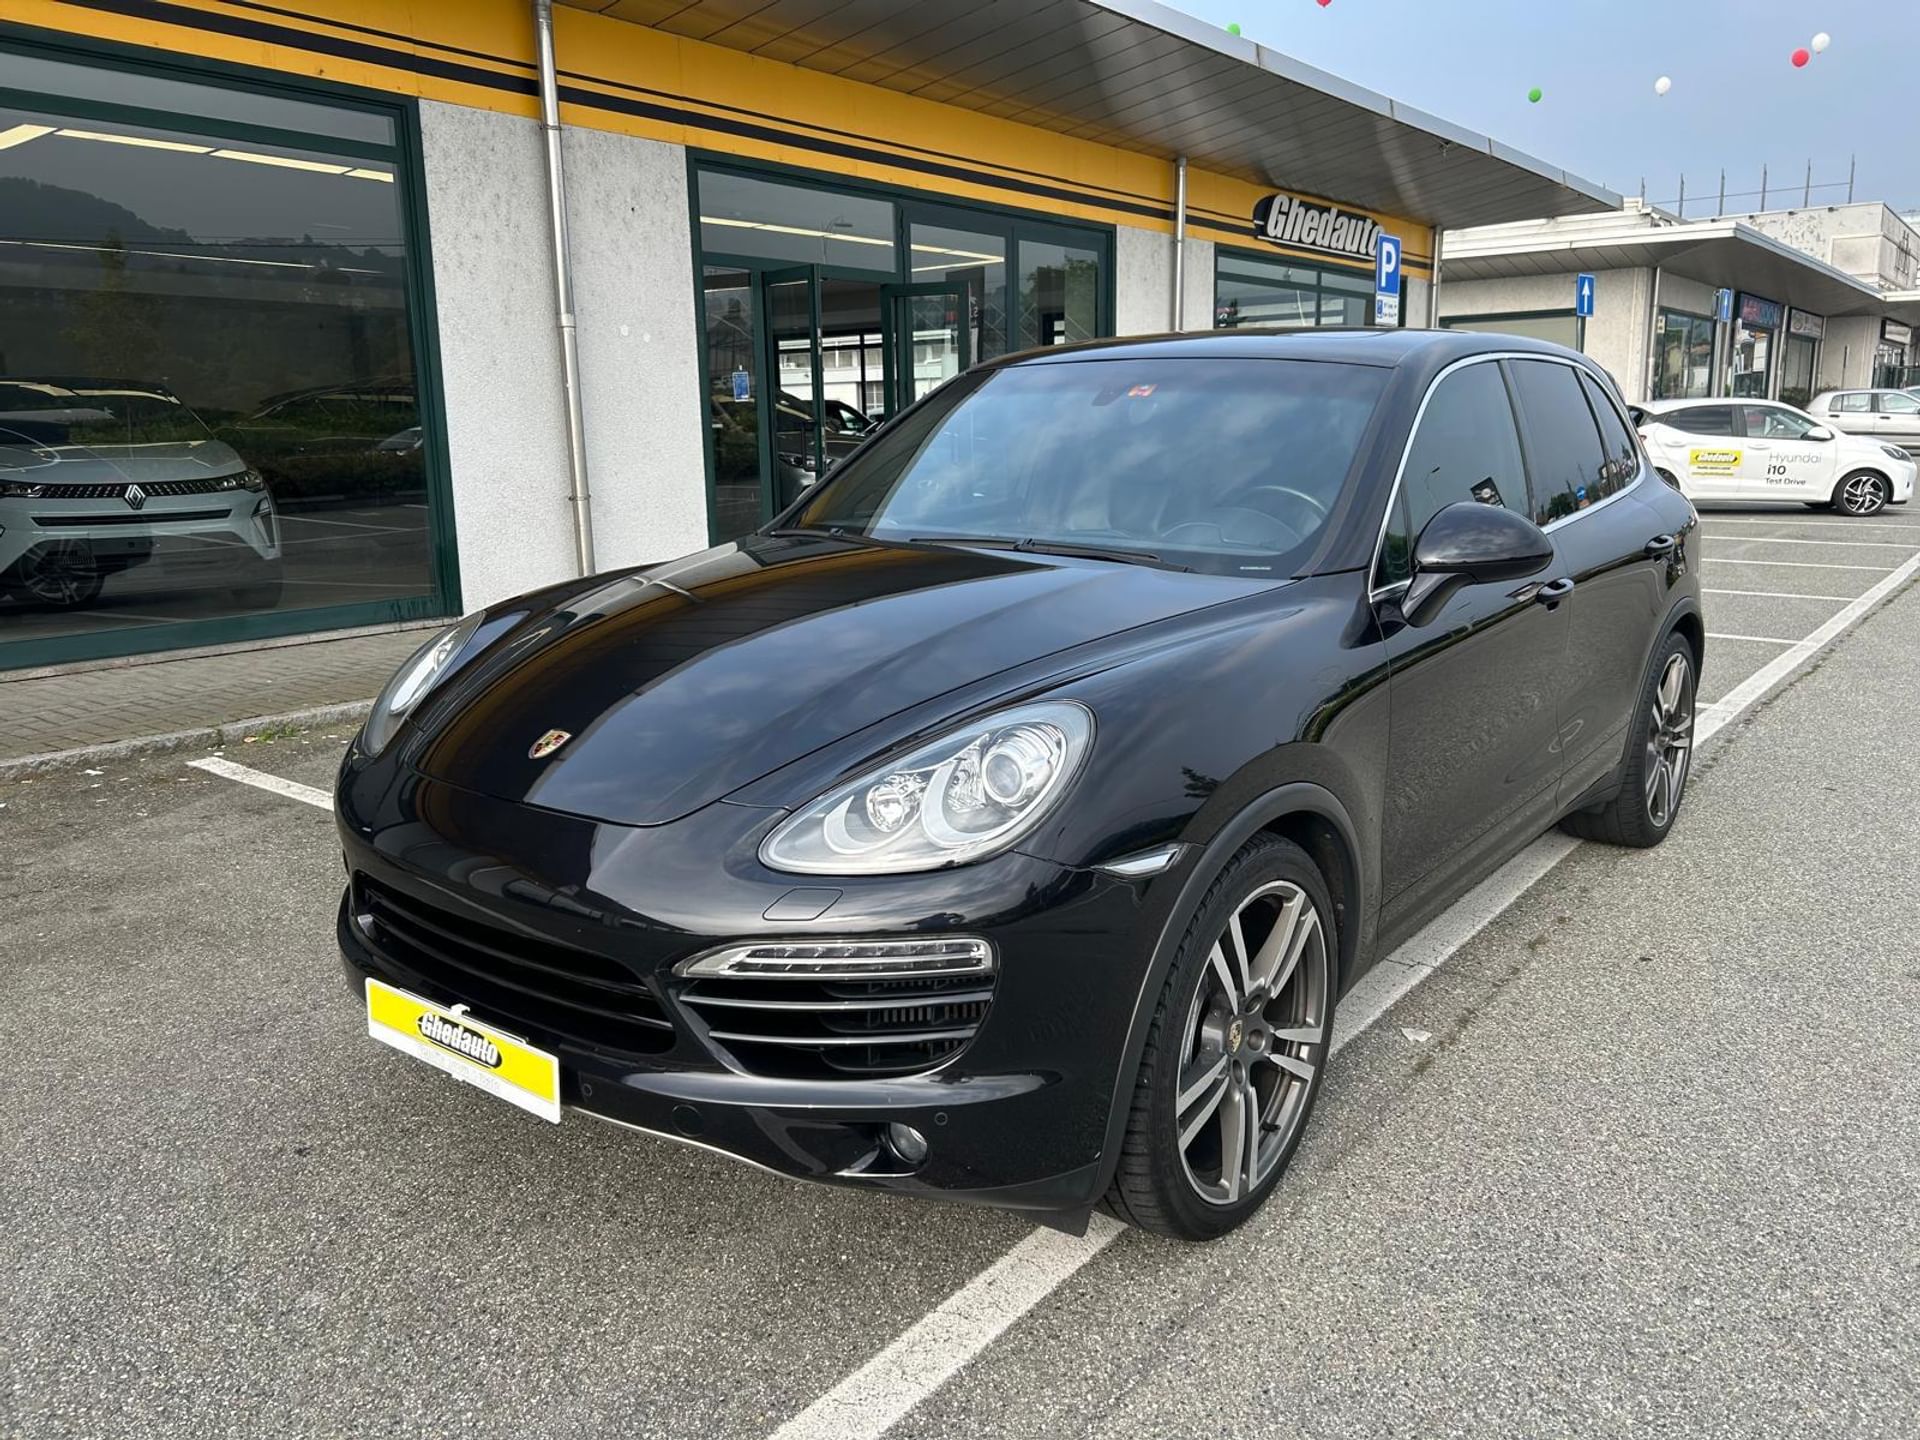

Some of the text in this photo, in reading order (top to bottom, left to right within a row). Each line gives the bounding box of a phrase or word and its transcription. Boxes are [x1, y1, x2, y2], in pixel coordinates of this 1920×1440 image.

[1381, 241, 1397, 287] P
[1768, 452, 1822, 464] Hyundai
[1767, 465, 1787, 475] i10
[1766, 477, 1806, 486] Test Drive
[421, 1012, 499, 1066] Ghedauto
